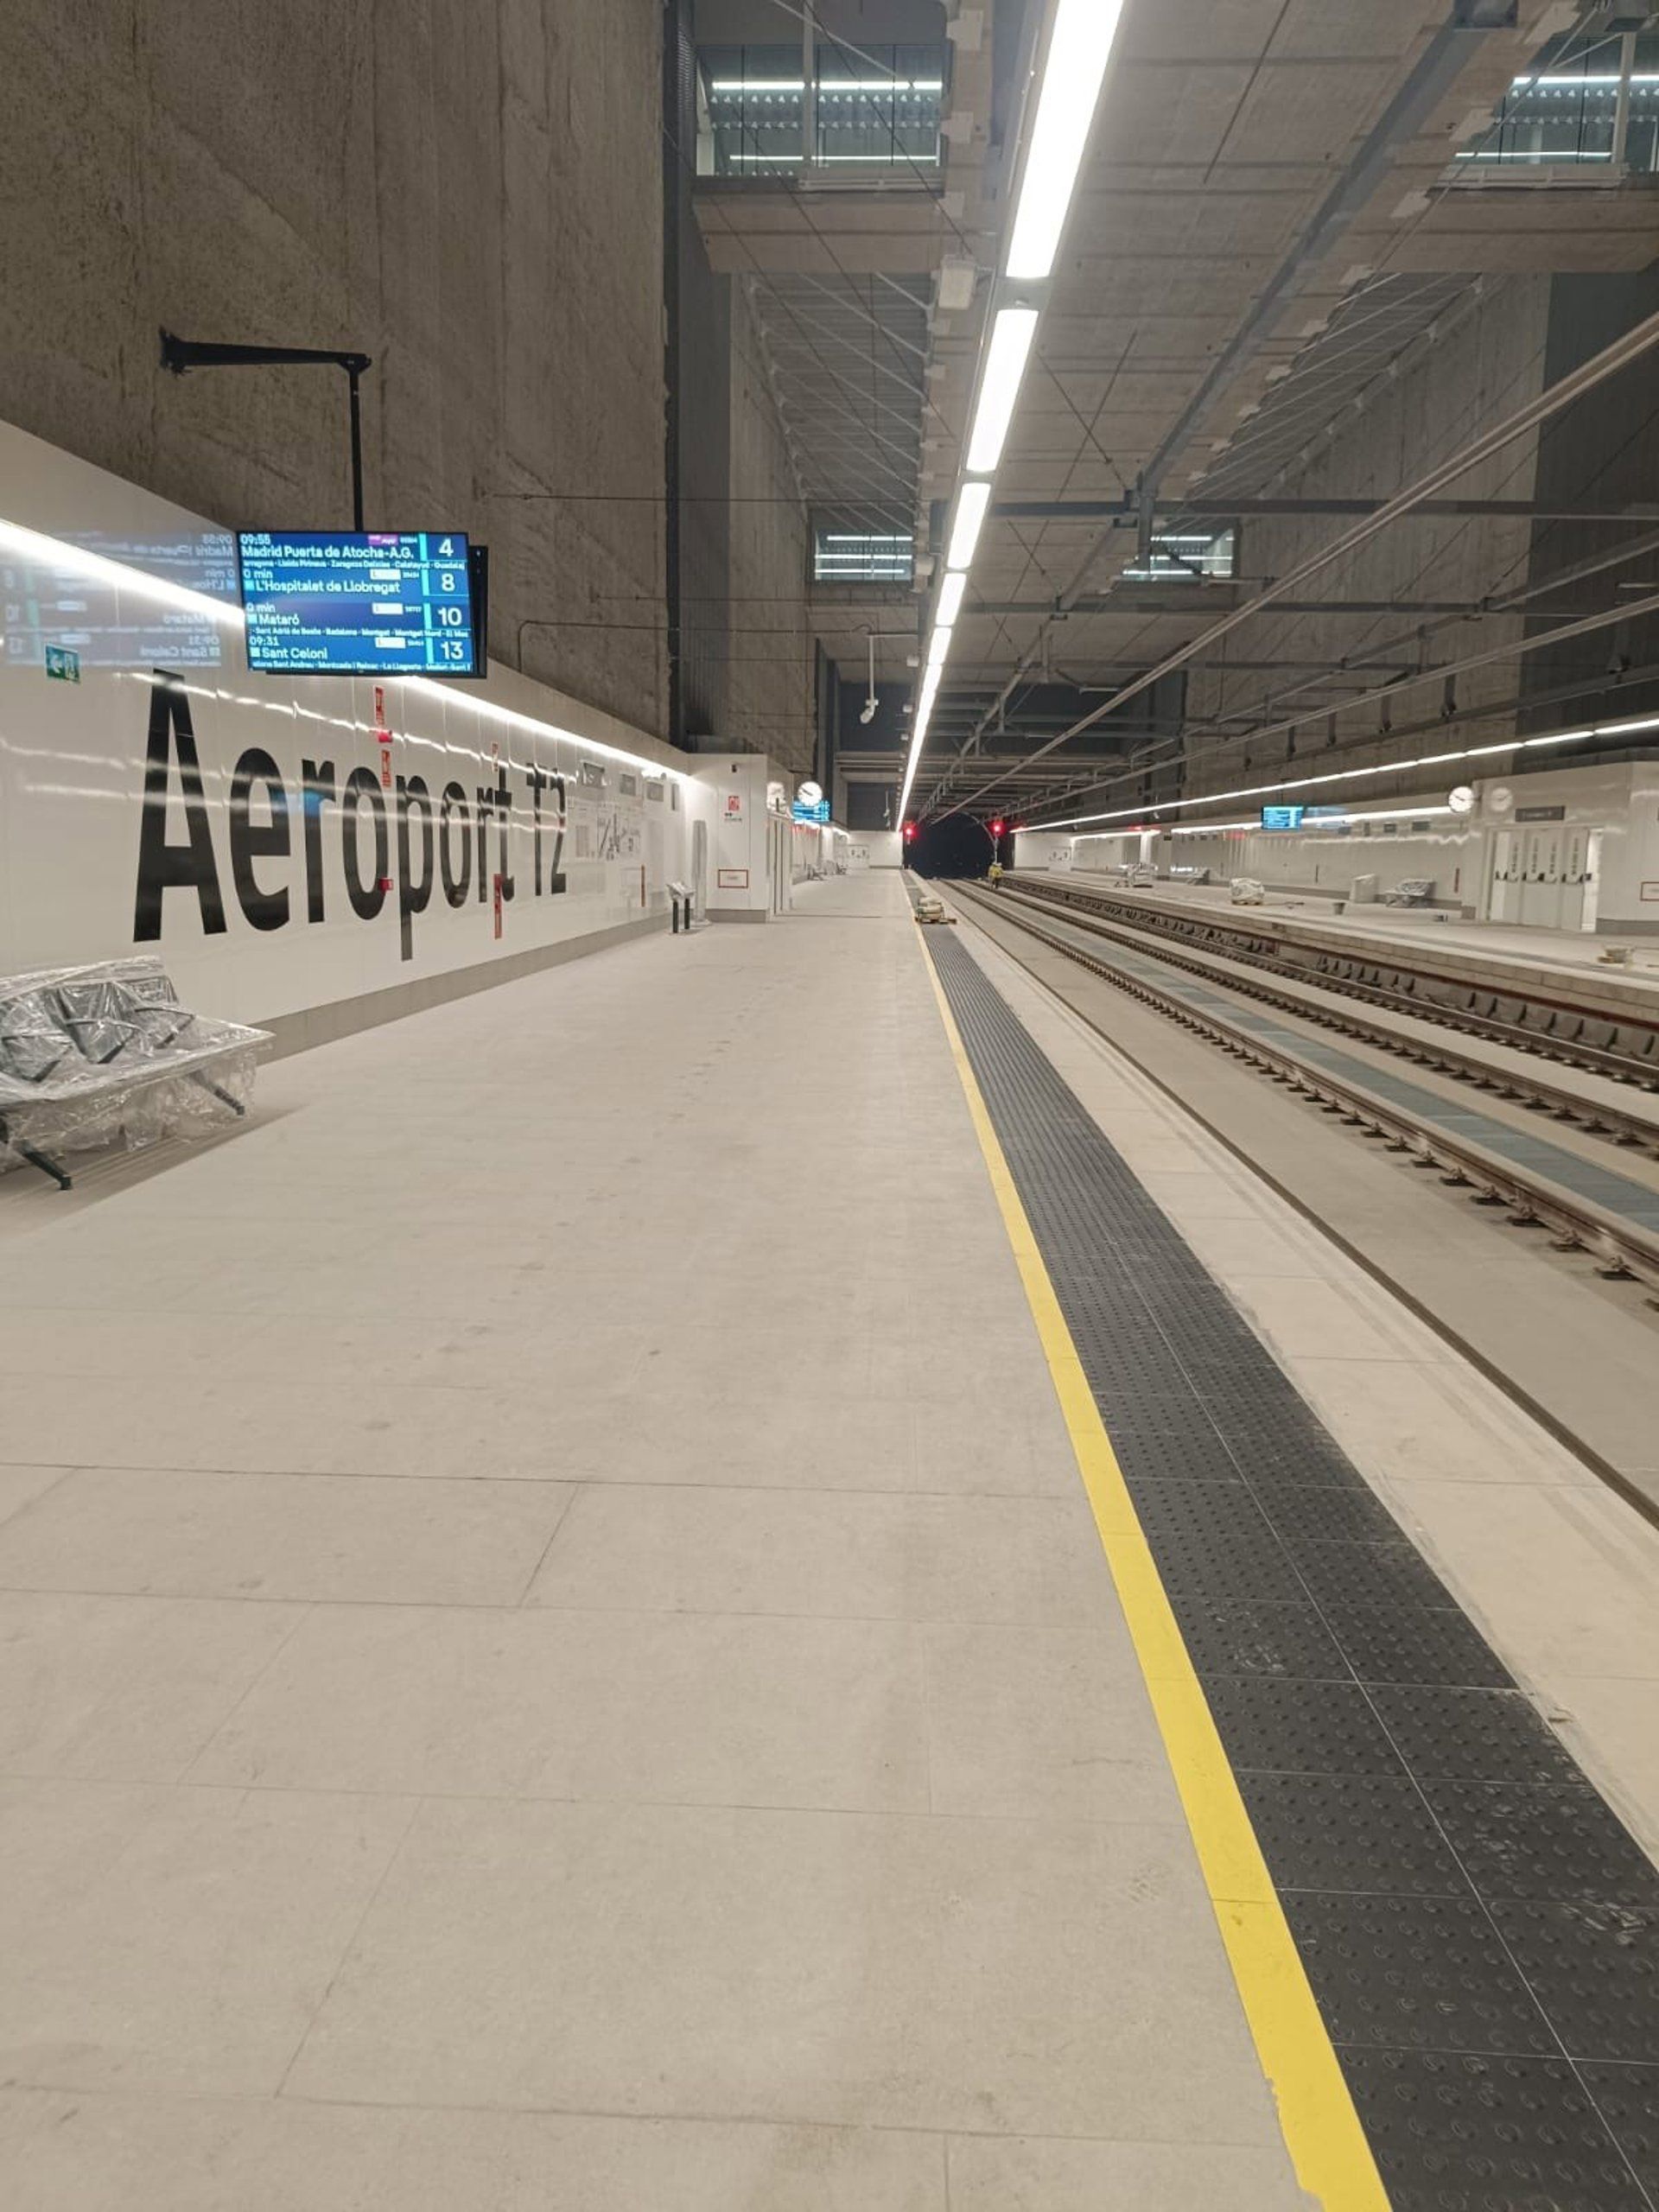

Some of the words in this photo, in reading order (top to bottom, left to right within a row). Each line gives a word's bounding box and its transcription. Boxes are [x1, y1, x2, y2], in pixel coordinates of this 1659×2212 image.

[240, 533, 270, 545] 09:55
[241, 545, 283, 558] Madrid
[283, 545, 323, 558] Puerta
[324, 545, 340, 558] de
[342, 546, 415, 560] Atocha-A.G.
[438, 537, 454, 557] 4
[243, 569, 251, 579] 0
[254, 569, 274, 579] min
[256, 580, 325, 594] L'Hospitalet
[326, 580, 341, 593] de
[343, 580, 400, 594] Llobregat
[441, 572, 456, 593] 8
[246, 602, 254, 613] 0
[257, 602, 276, 613] min
[259, 613, 300, 626] Mataró
[437, 607, 463, 626] 10
[249, 636, 280, 646] 09:31
[262, 647, 289, 658] Sant
[290, 647, 328, 659] Celoni
[441, 640, 465, 661] 13
[133, 668, 515, 961] Aeroport
[526, 762, 567, 896] T2
